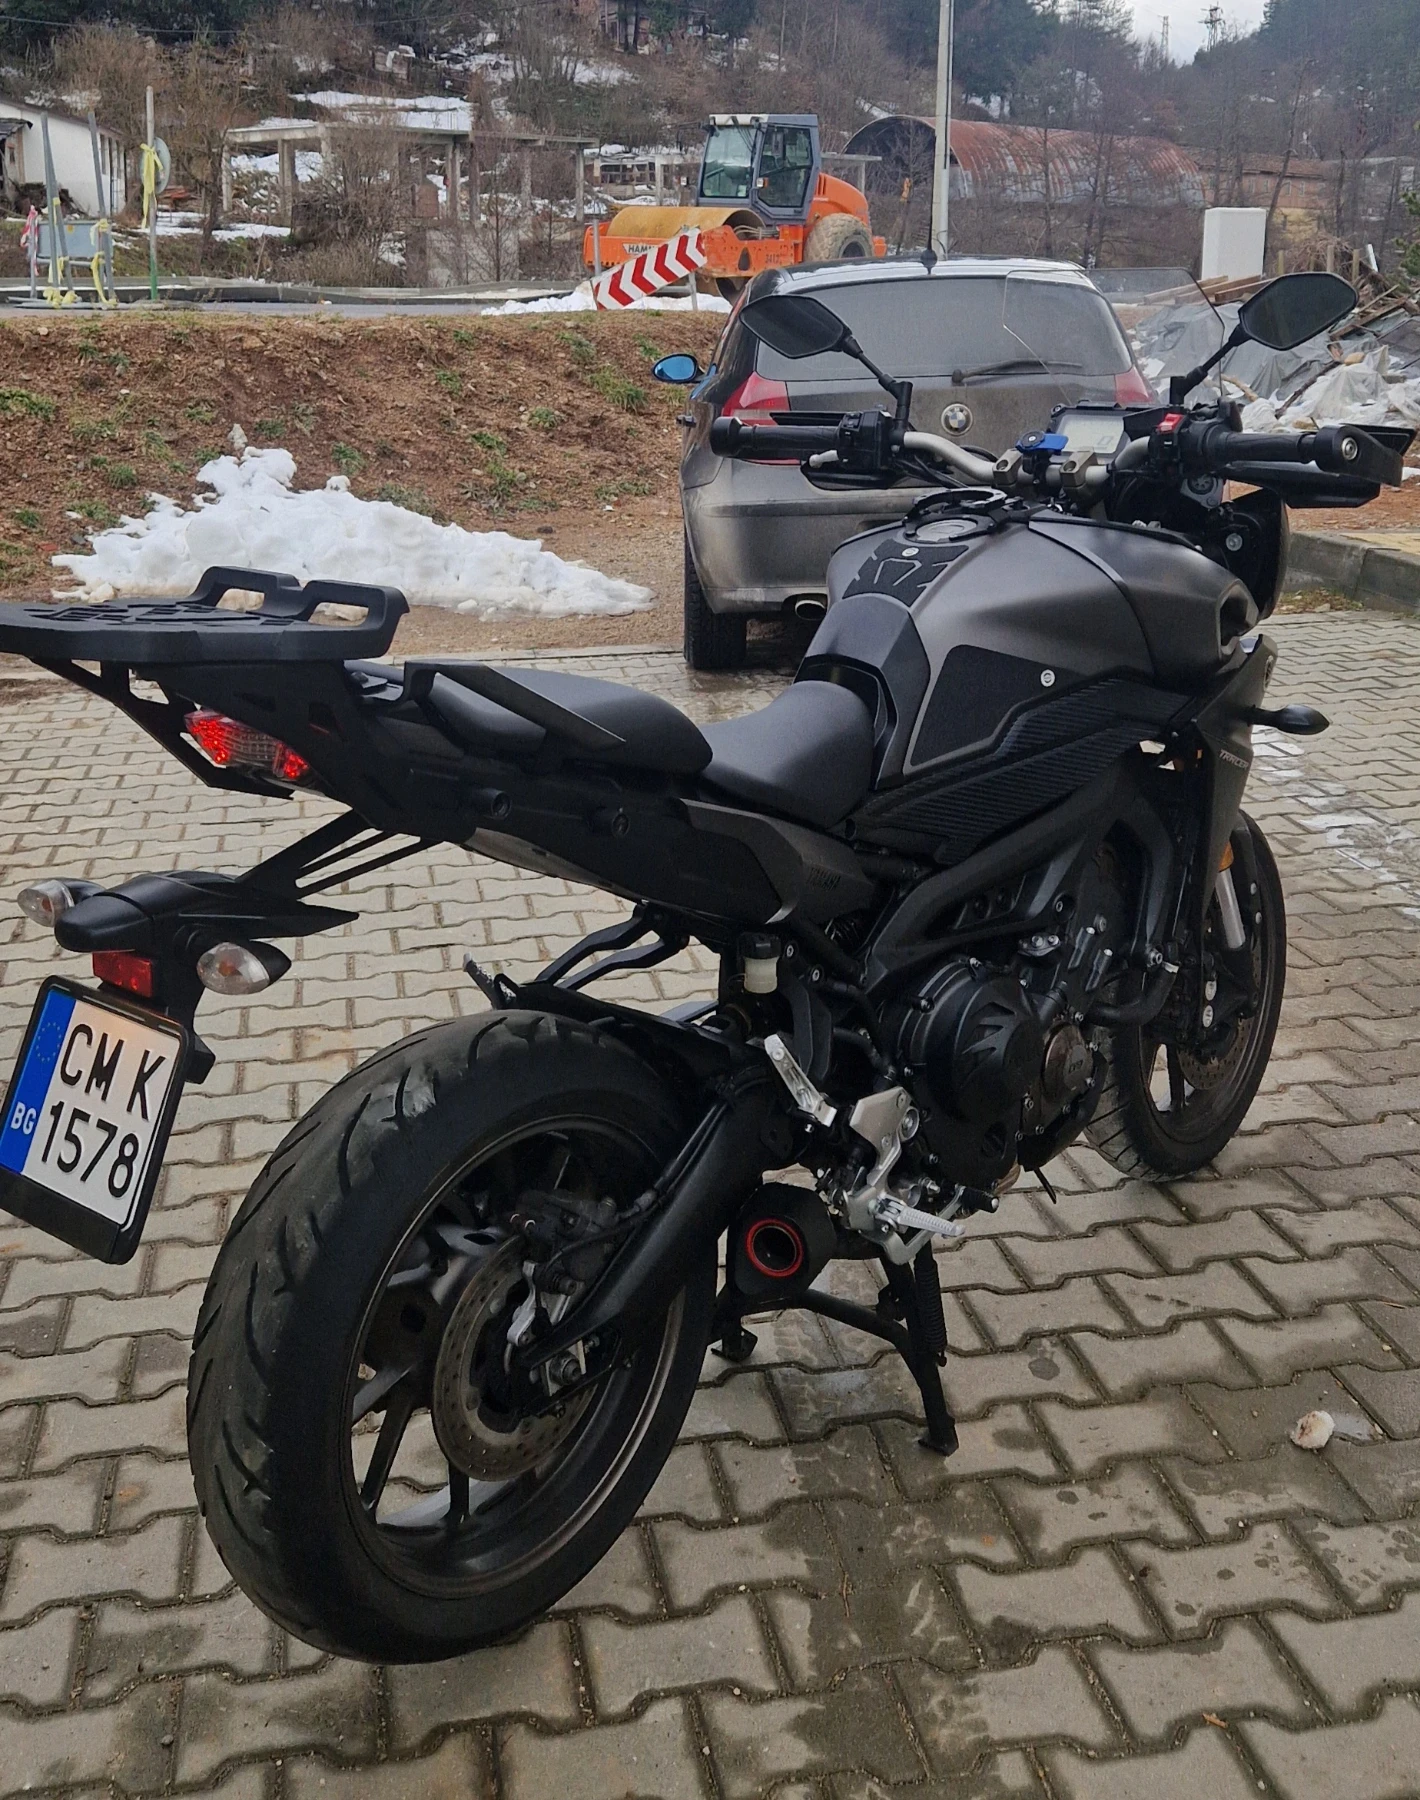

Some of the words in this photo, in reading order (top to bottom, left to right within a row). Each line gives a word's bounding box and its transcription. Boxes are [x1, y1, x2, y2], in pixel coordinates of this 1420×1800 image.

[629, 245, 654, 253] HAM
[61, 1024, 124, 1101] CM
[127, 1050, 166, 1120] K
[10, 1102, 37, 1134] BG
[41, 1101, 139, 1198] 1578
